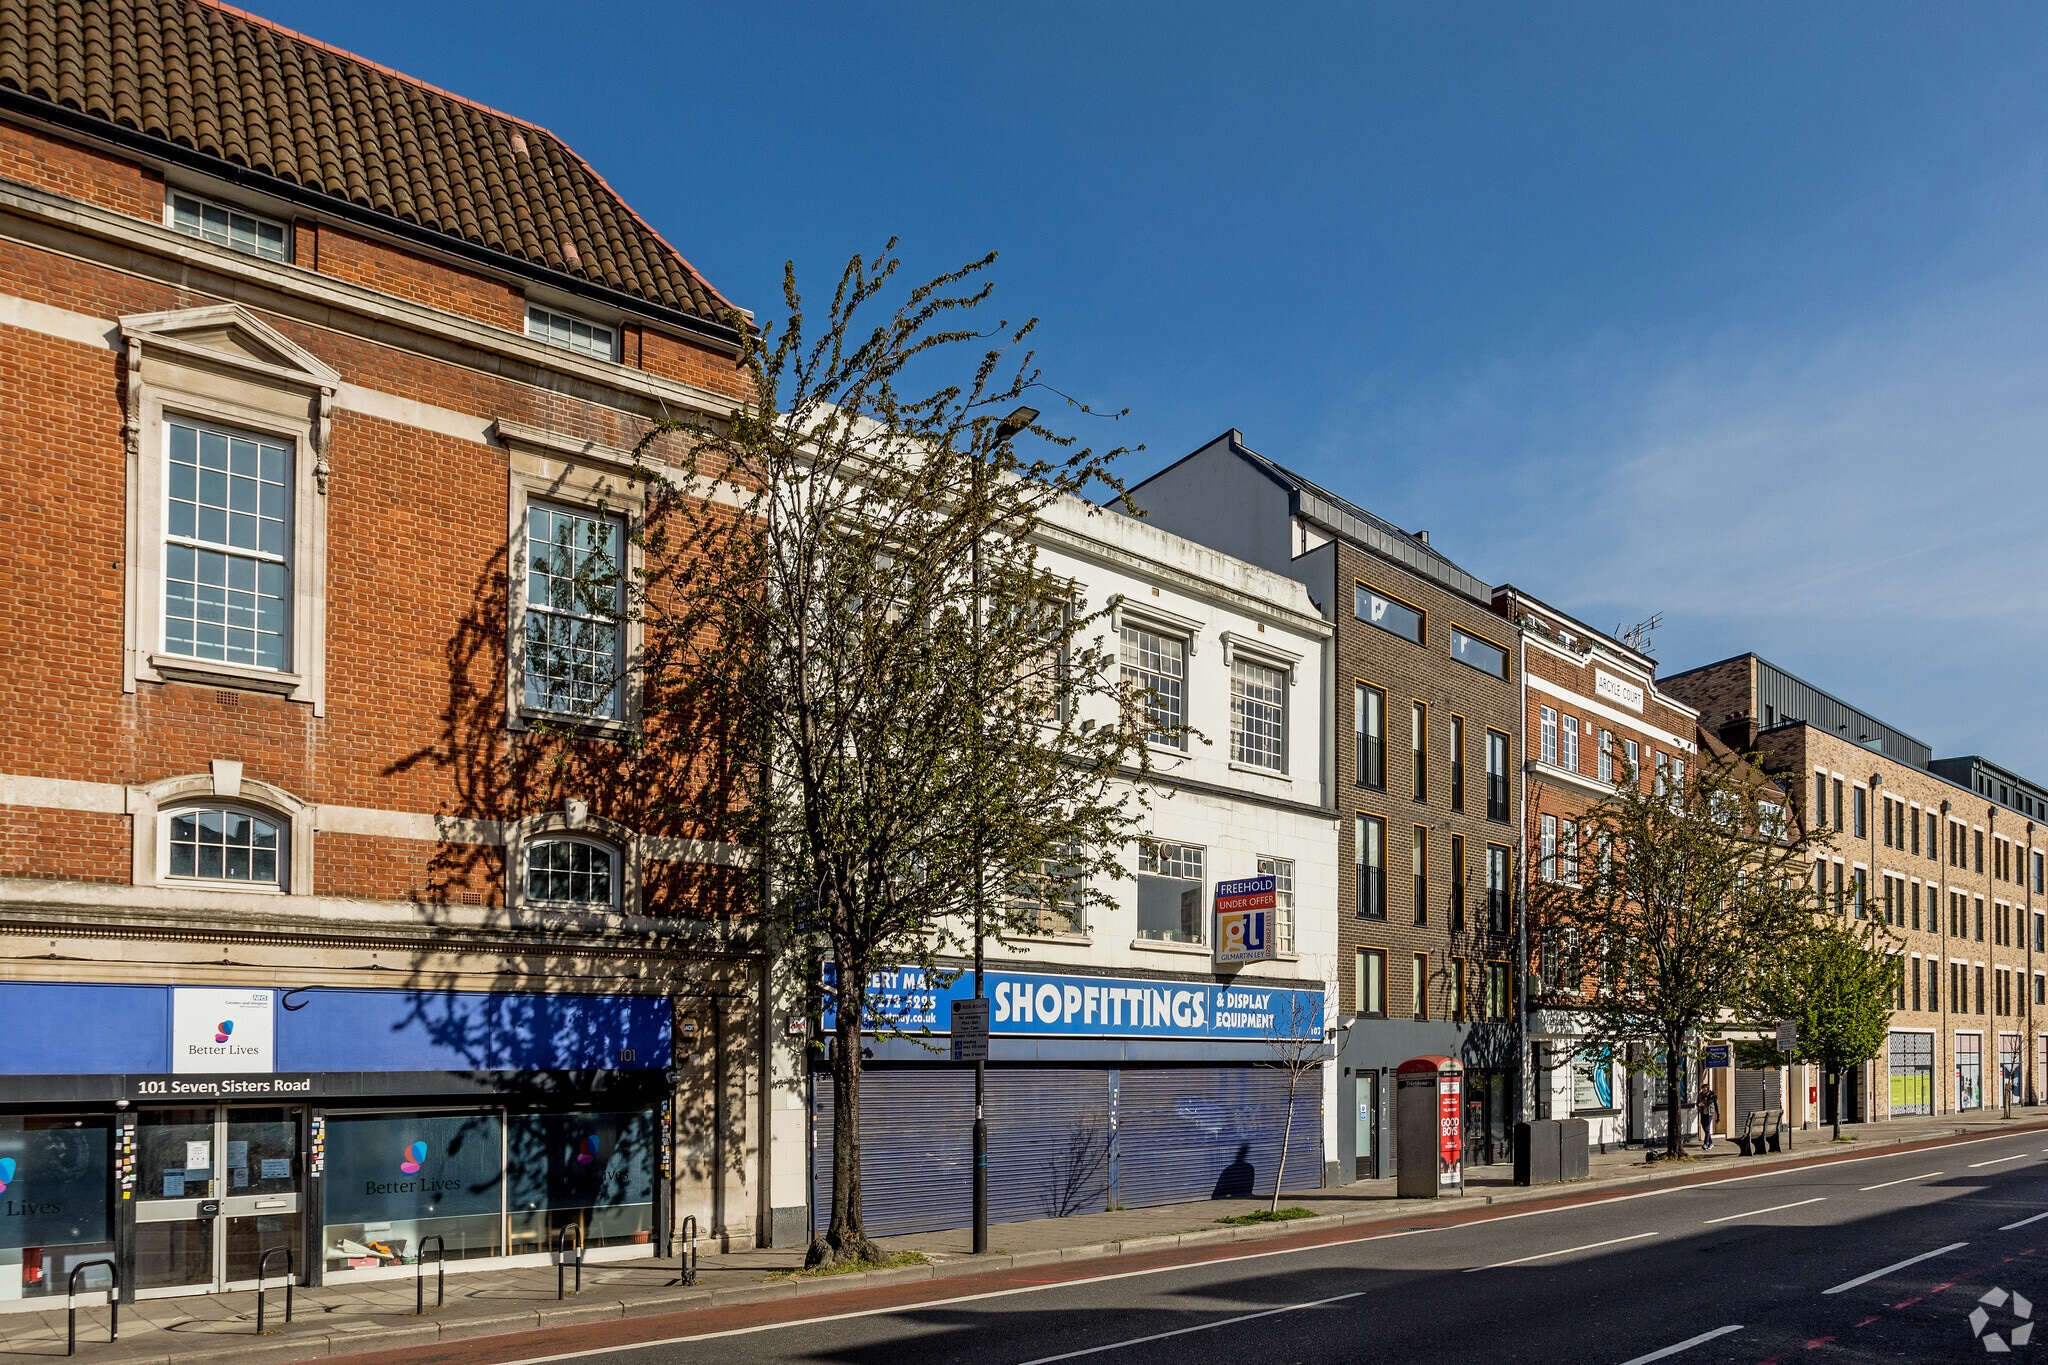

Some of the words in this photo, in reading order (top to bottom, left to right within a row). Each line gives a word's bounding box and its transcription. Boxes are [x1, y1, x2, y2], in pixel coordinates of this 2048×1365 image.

[1622, 687, 1641, 705] COURT
[1221, 880, 1273, 895] FREEHOLD
[1219, 899, 1248, 910] UNDER
[1249, 895, 1274, 906] OFFER
[1221, 952, 1254, 961] GILMARTIN
[1254, 950, 1265, 959] LEY
[866, 971, 899, 989] ERT
[995, 981, 1207, 1029] SHOPFITTINGS
[1216, 992, 1225, 1008] &
[1226, 991, 1273, 1010] DISPLAY
[1215, 1011, 1275, 1030] EQUIPMENT
[188, 1044, 226, 1055] Better
[229, 1044, 259, 1055] Lives
[619, 1048, 636, 1062] 101
[138, 1081, 167, 1094] 101
[171, 1080, 217, 1093] Seven
[221, 1079, 270, 1092] Sisters
[274, 1078, 311, 1091] Road
[1441, 1117, 1460, 1127] GOOD
[1442, 1126, 1458, 1137] BOYS
[365, 1181, 416, 1196] Better
[420, 1177, 461, 1192] Lives
[6, 1199, 62, 1217] Lives
